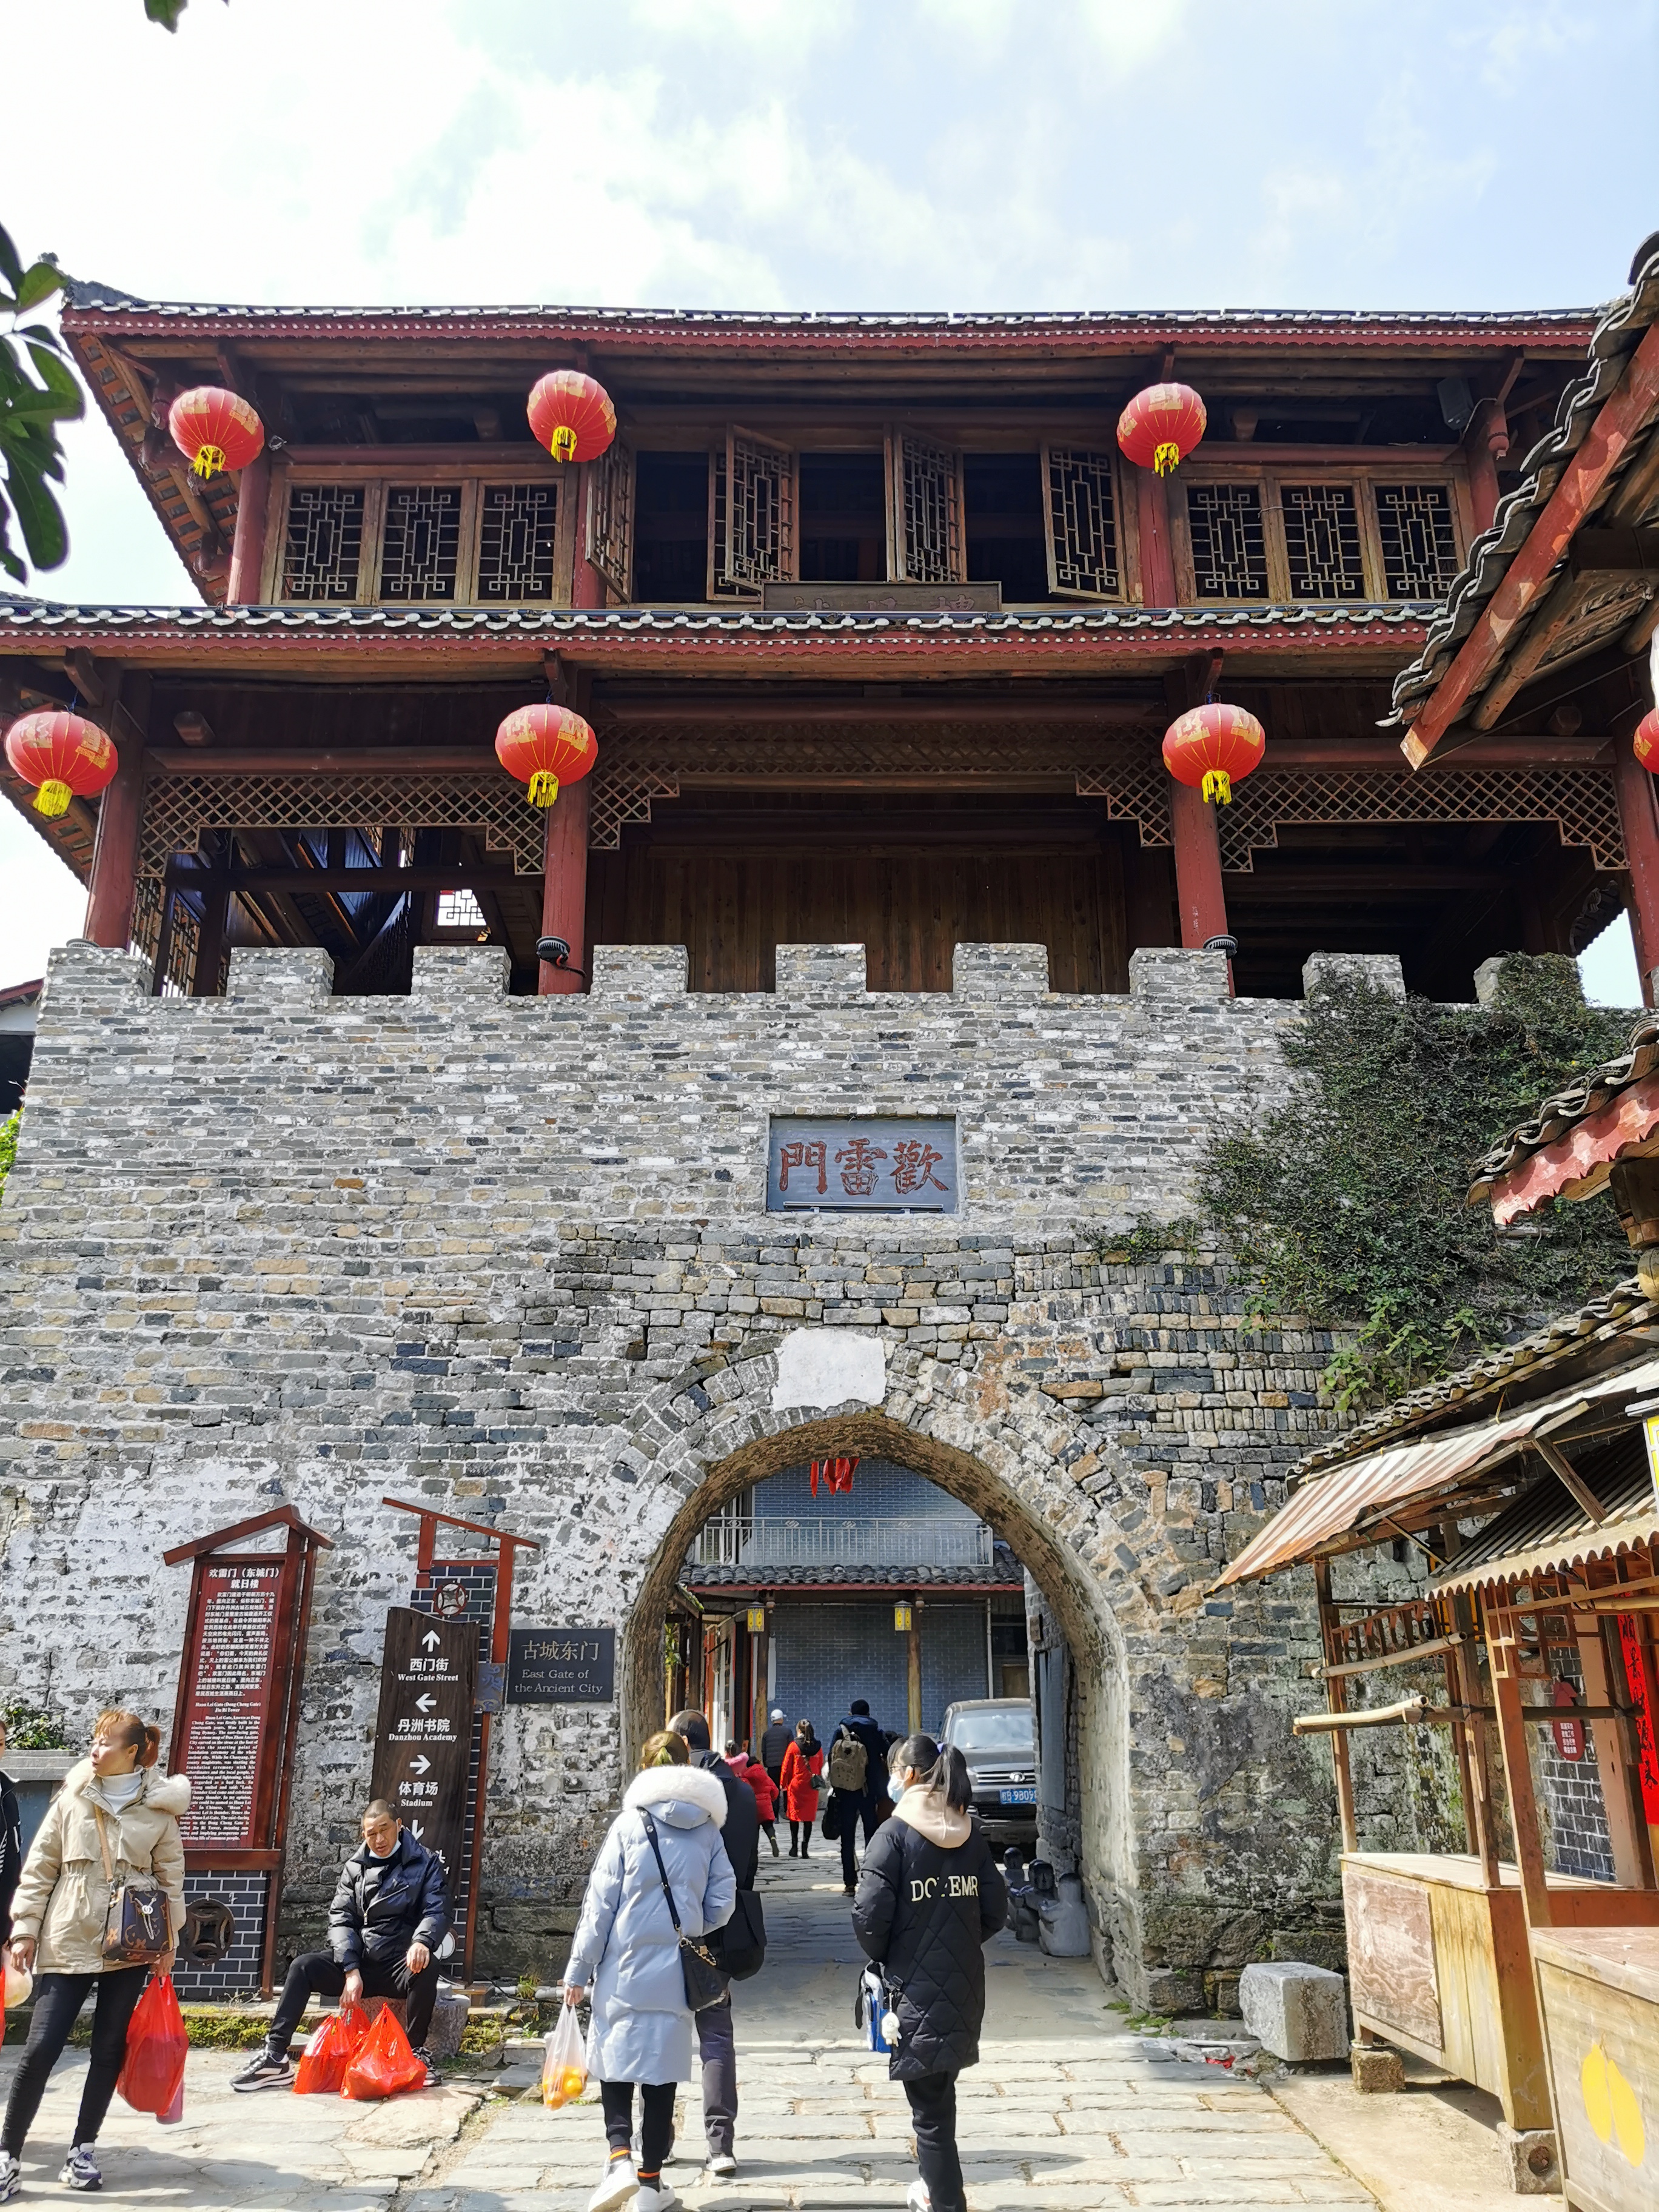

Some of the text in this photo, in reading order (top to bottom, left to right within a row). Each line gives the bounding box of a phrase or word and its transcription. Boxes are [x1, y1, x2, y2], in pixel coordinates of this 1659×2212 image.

[209, 1567, 280, 1578] 欢雷门（东城门）
[230, 1579, 260, 1589] 就日楼
[521, 1640, 600, 1661] 古城东门
[410, 1658, 449, 1672] 西门街
[522, 1669, 589, 1678] East Gate of
[515, 1683, 603, 1695] the Ancient City
[398, 1718, 450, 1732] 丹洲书院
[398, 1781, 438, 1796] 体育场
